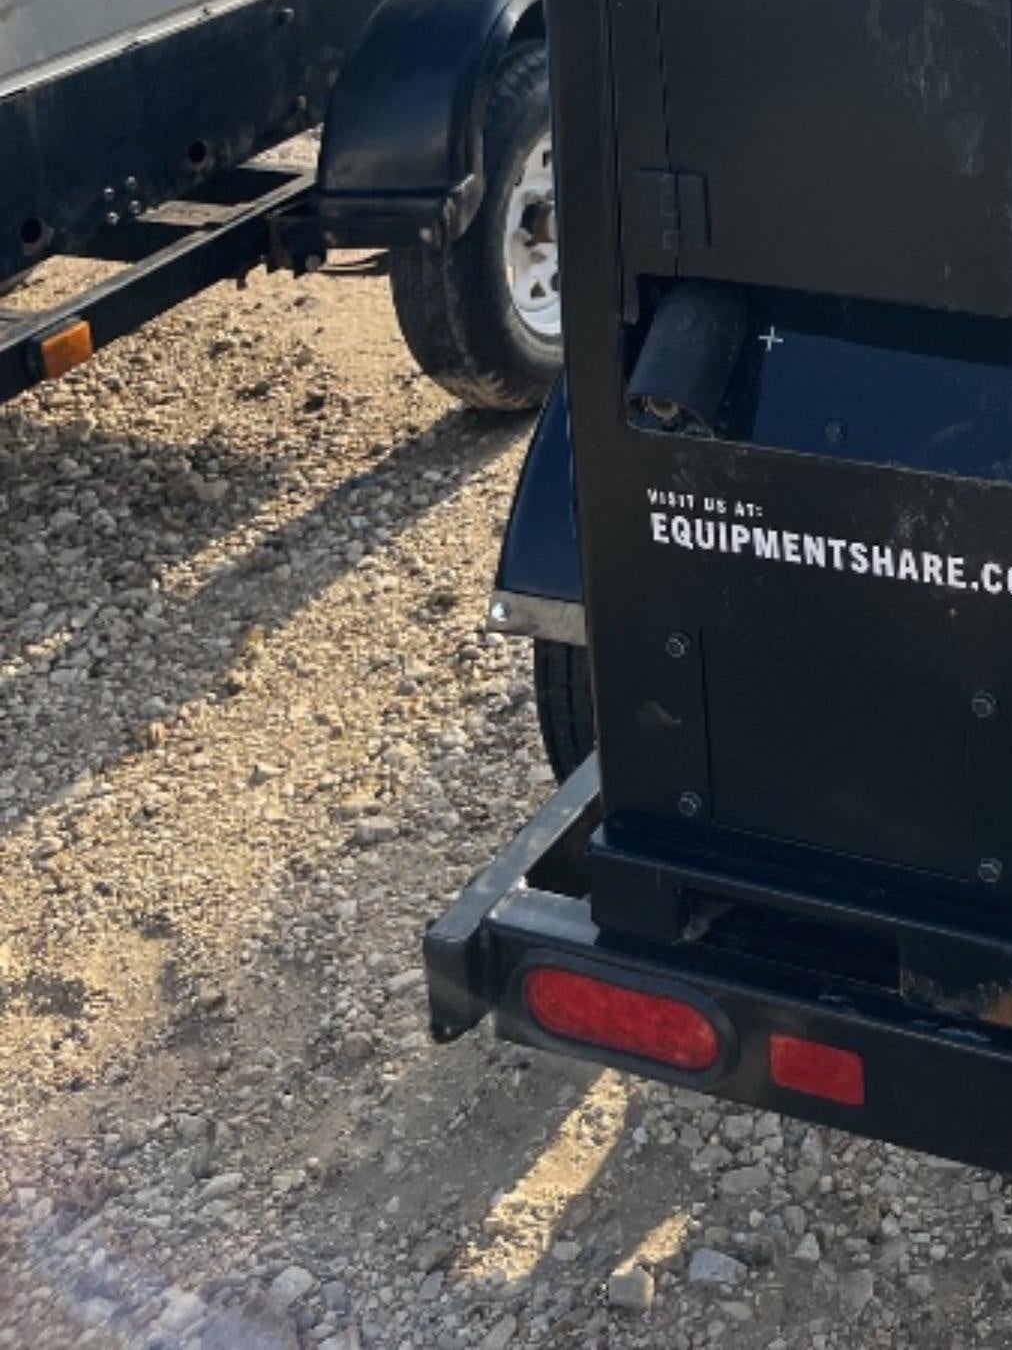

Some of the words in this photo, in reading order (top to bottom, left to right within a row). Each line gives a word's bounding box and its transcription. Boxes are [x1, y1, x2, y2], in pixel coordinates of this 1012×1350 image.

[647, 487, 695, 510] VISIT
[703, 496, 727, 514] US
[734, 500, 764, 517] AT:
